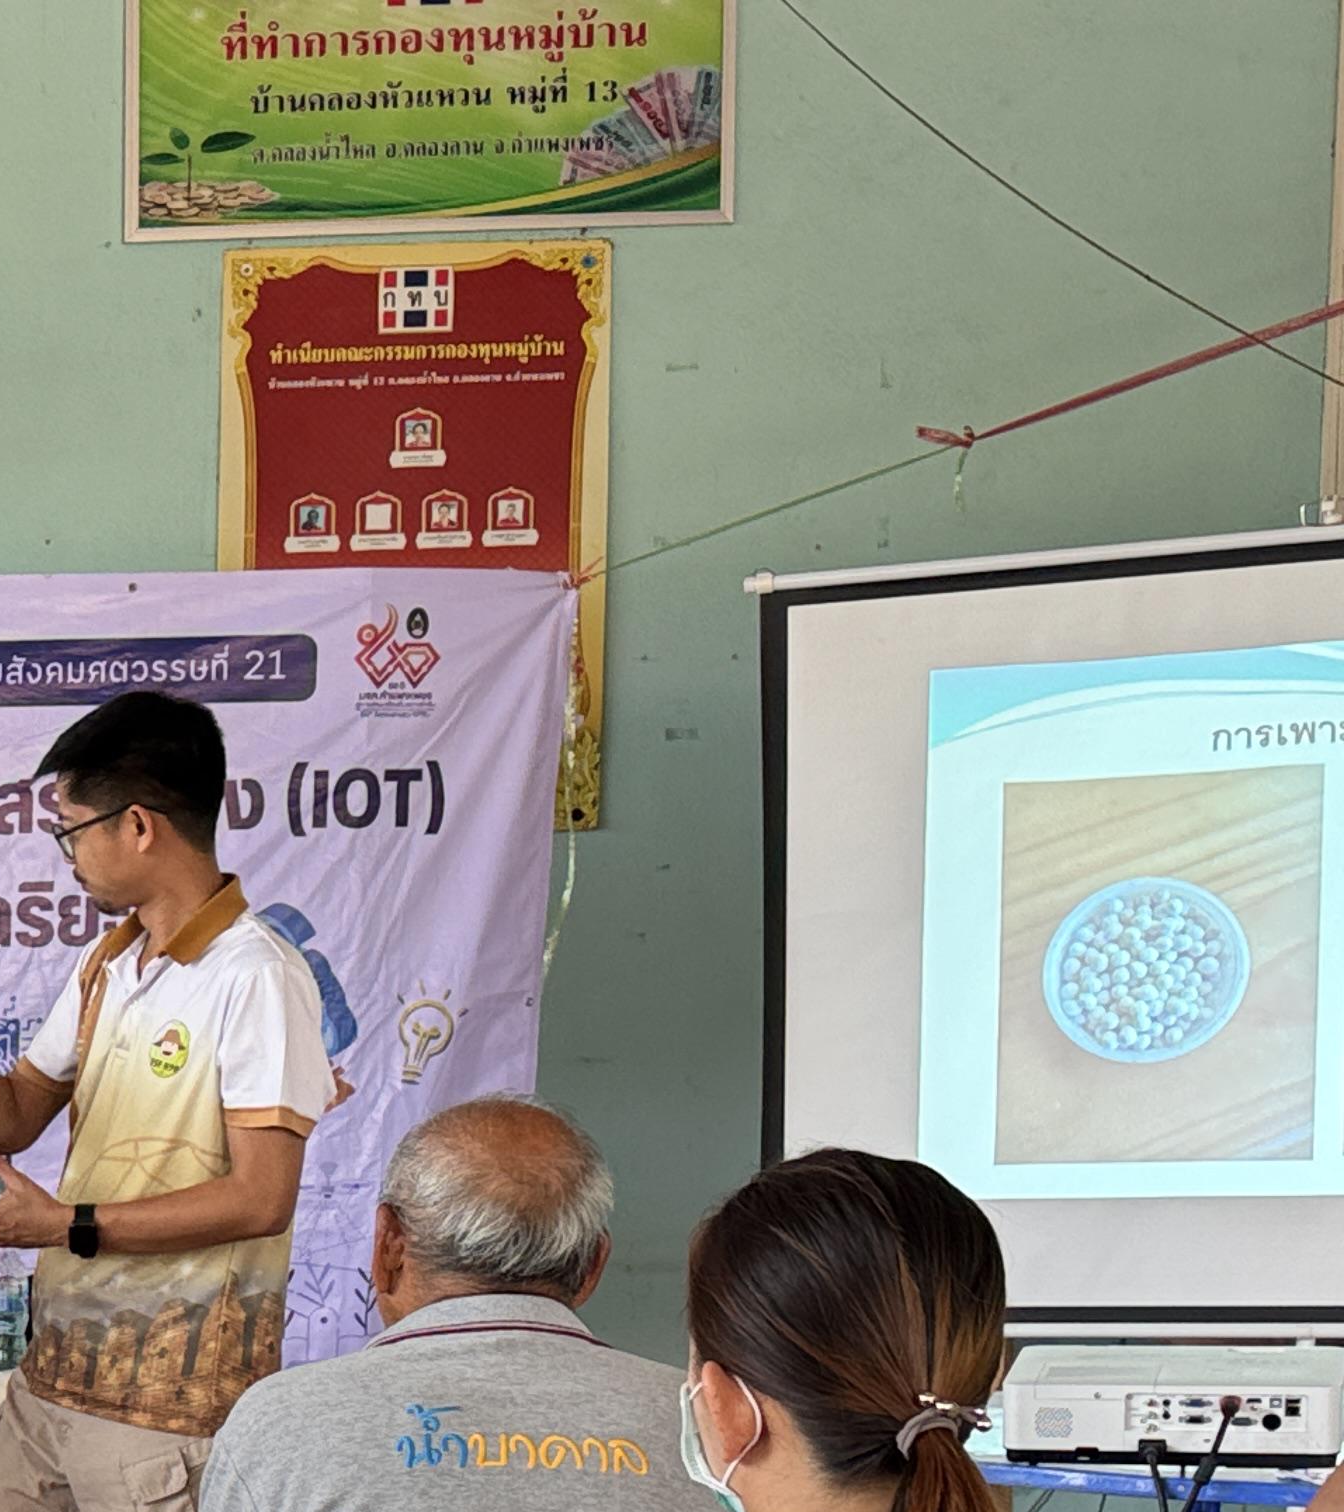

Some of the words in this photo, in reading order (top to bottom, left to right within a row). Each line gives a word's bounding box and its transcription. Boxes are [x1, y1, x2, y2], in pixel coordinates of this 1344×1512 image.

[220, 8, 648, 65] ที่ทำการกองทุนหมู่บ้าน
[250, 84, 493, 115] บ้านคลองหัวแหวน
[506, 69, 569, 114] หมู่ที่
[584, 79, 619, 104] 13
[382, 290, 397, 308] ก
[407, 290, 423, 307] ท
[434, 289, 449, 307] บ
[243, 649, 289, 681] 21
[286, 760, 446, 836] (IOT)
[394, 1402, 651, 1476] น้ำบาดาล
